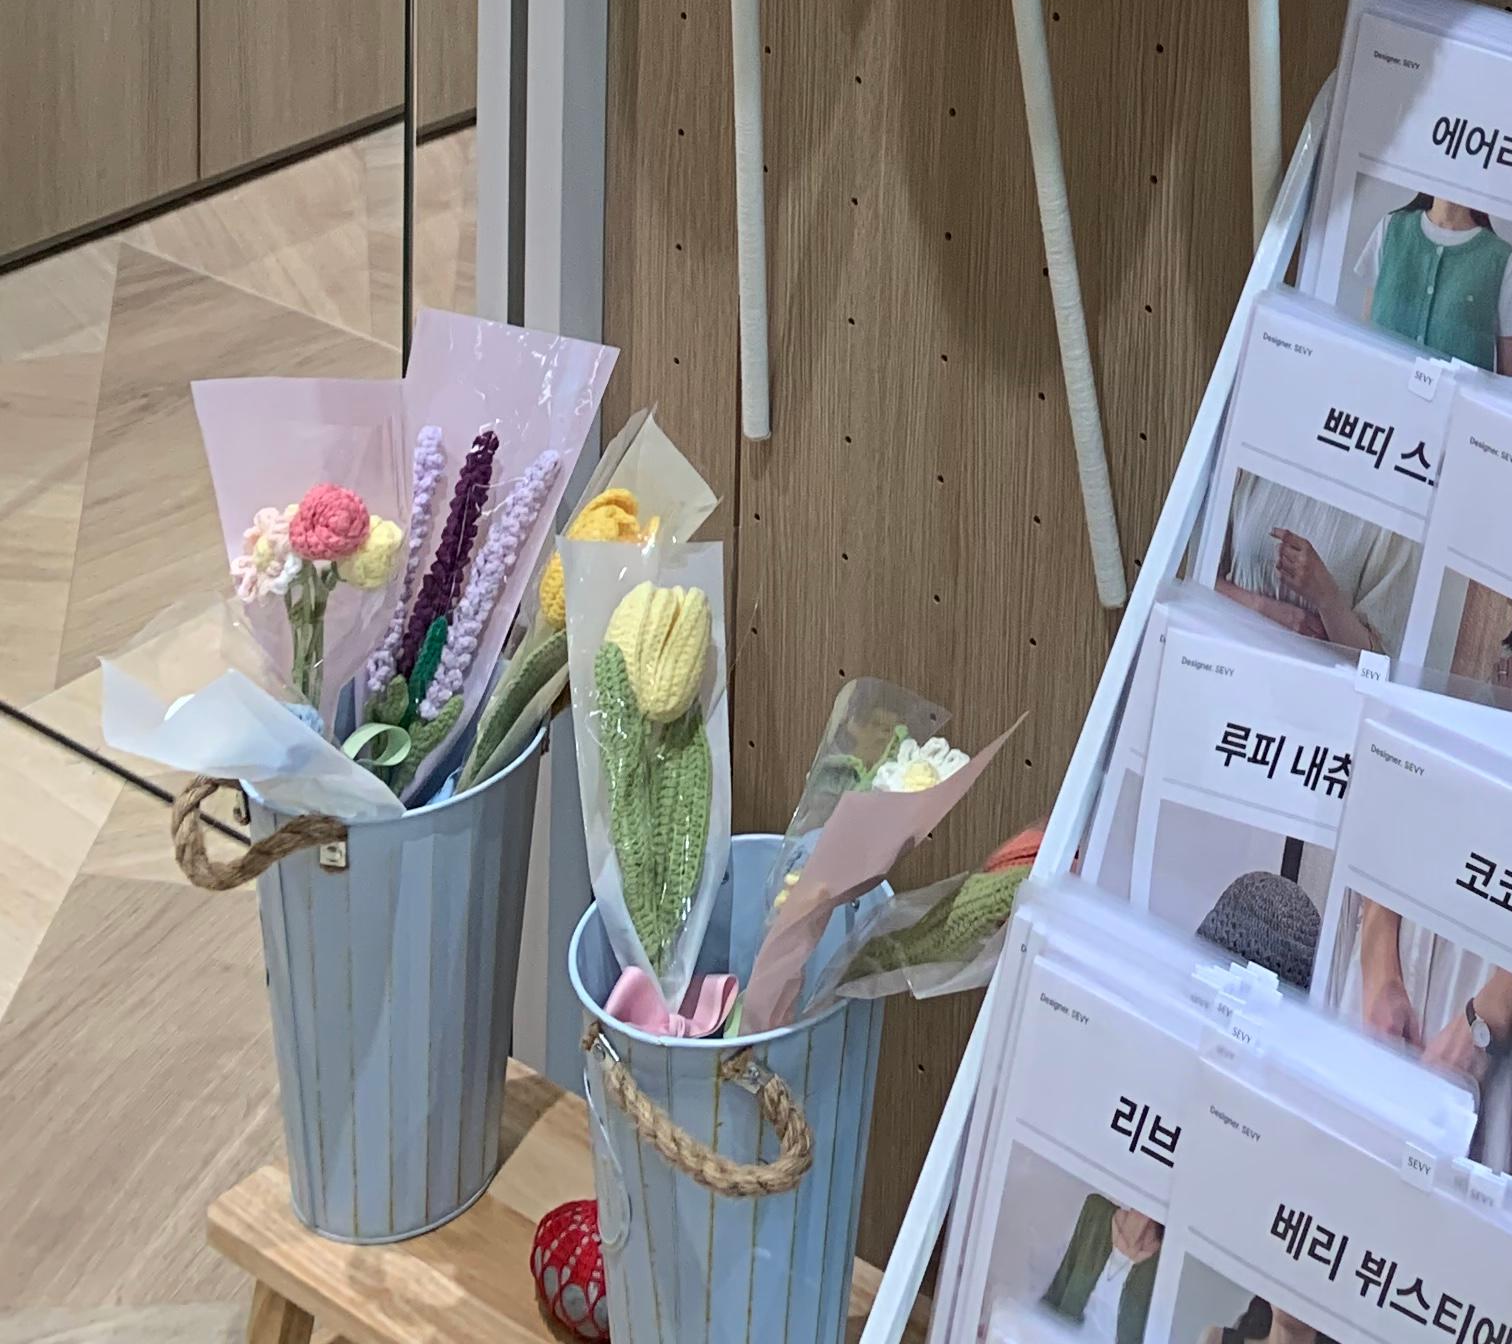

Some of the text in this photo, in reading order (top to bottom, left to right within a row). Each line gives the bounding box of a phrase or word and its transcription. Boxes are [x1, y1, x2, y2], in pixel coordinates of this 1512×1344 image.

[1414, 371, 1433, 386] SEVY
[1317, 408, 1394, 469] 쁘띠
[1361, 667, 1381, 681] SEVY
[1215, 722, 1286, 779] 루피
[1232, 1026, 1251, 1043] SEVY
[1408, 1156, 1431, 1175] SEVY
[1270, 1203, 1348, 1281] 베리
